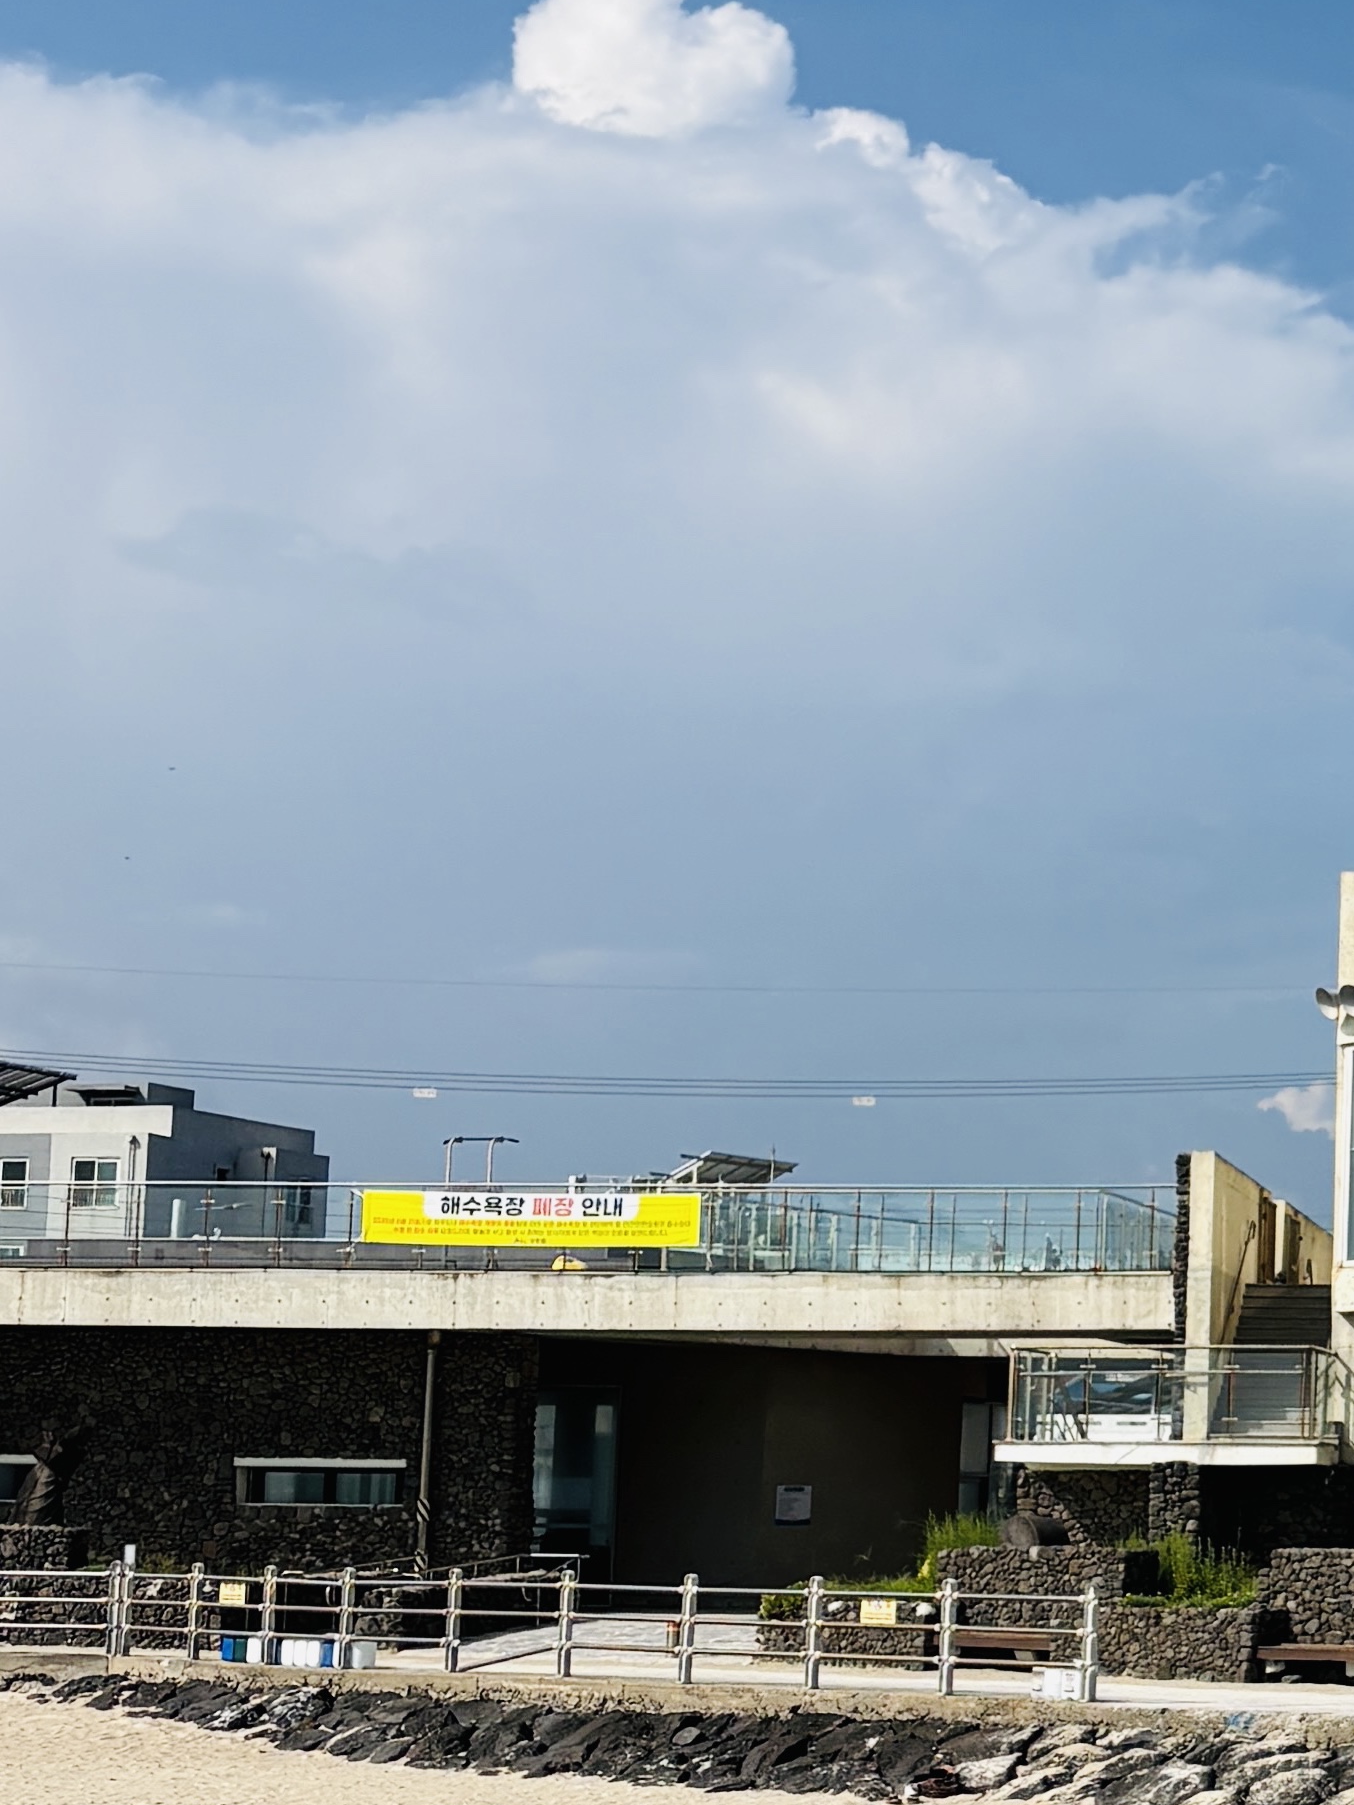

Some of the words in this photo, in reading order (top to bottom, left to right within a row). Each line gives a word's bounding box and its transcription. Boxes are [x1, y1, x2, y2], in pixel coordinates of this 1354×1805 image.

[441, 1196, 524, 1215] 해수욕장
[533, 1197, 574, 1216] 폐장
[582, 1197, 623, 1217] 안내
